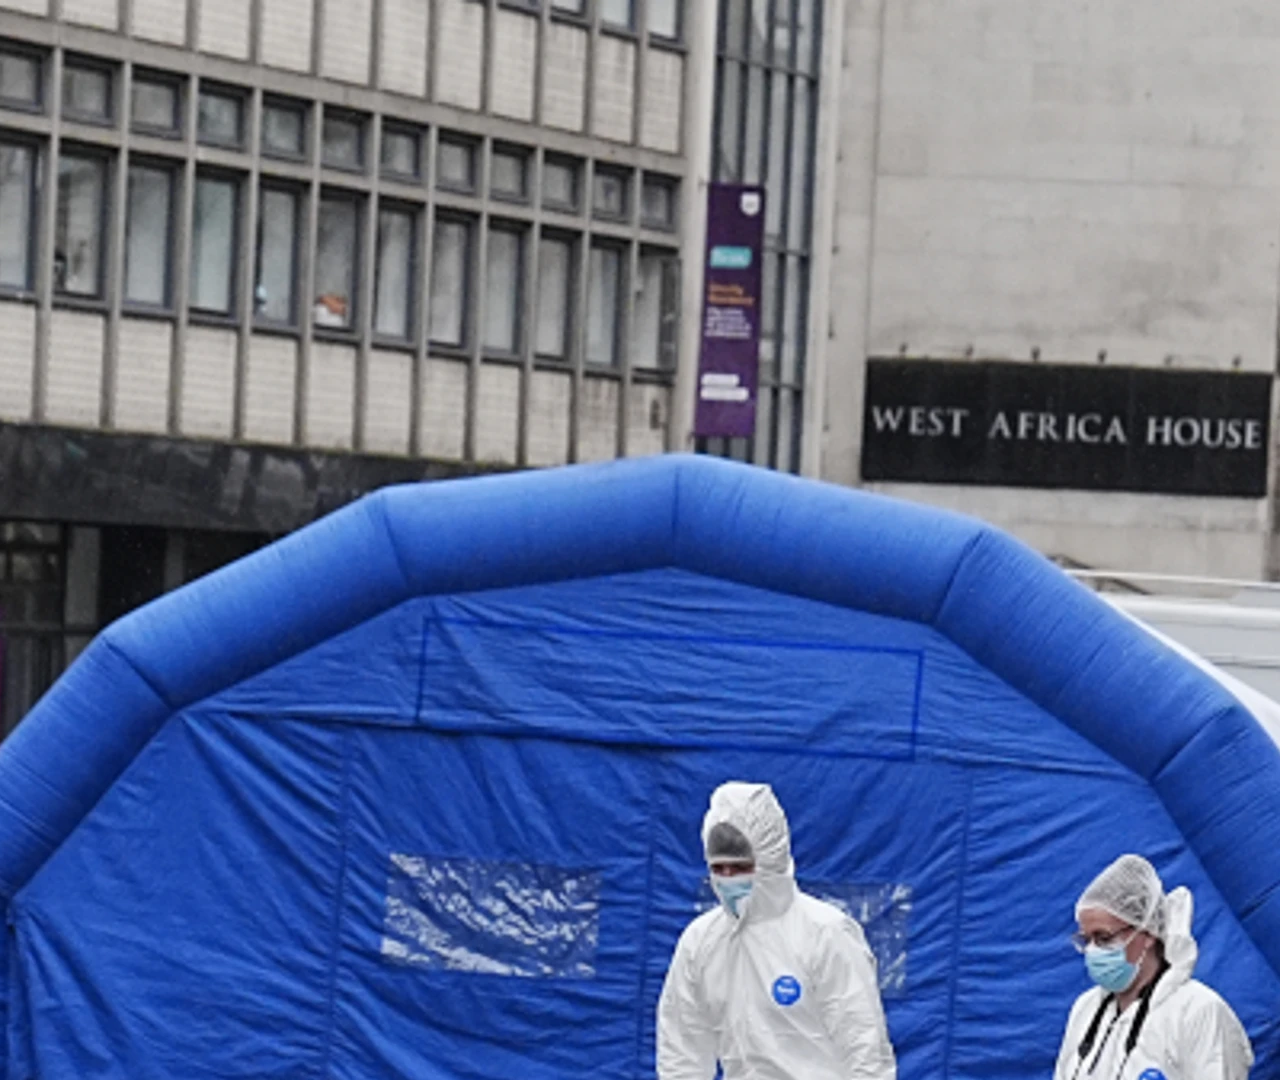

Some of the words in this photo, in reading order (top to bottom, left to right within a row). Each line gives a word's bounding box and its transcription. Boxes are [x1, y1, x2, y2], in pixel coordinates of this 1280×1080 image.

[871, 405, 970, 437] WEST
[988, 410, 1128, 444] AFRICA
[1146, 415, 1263, 450] HOUSE
